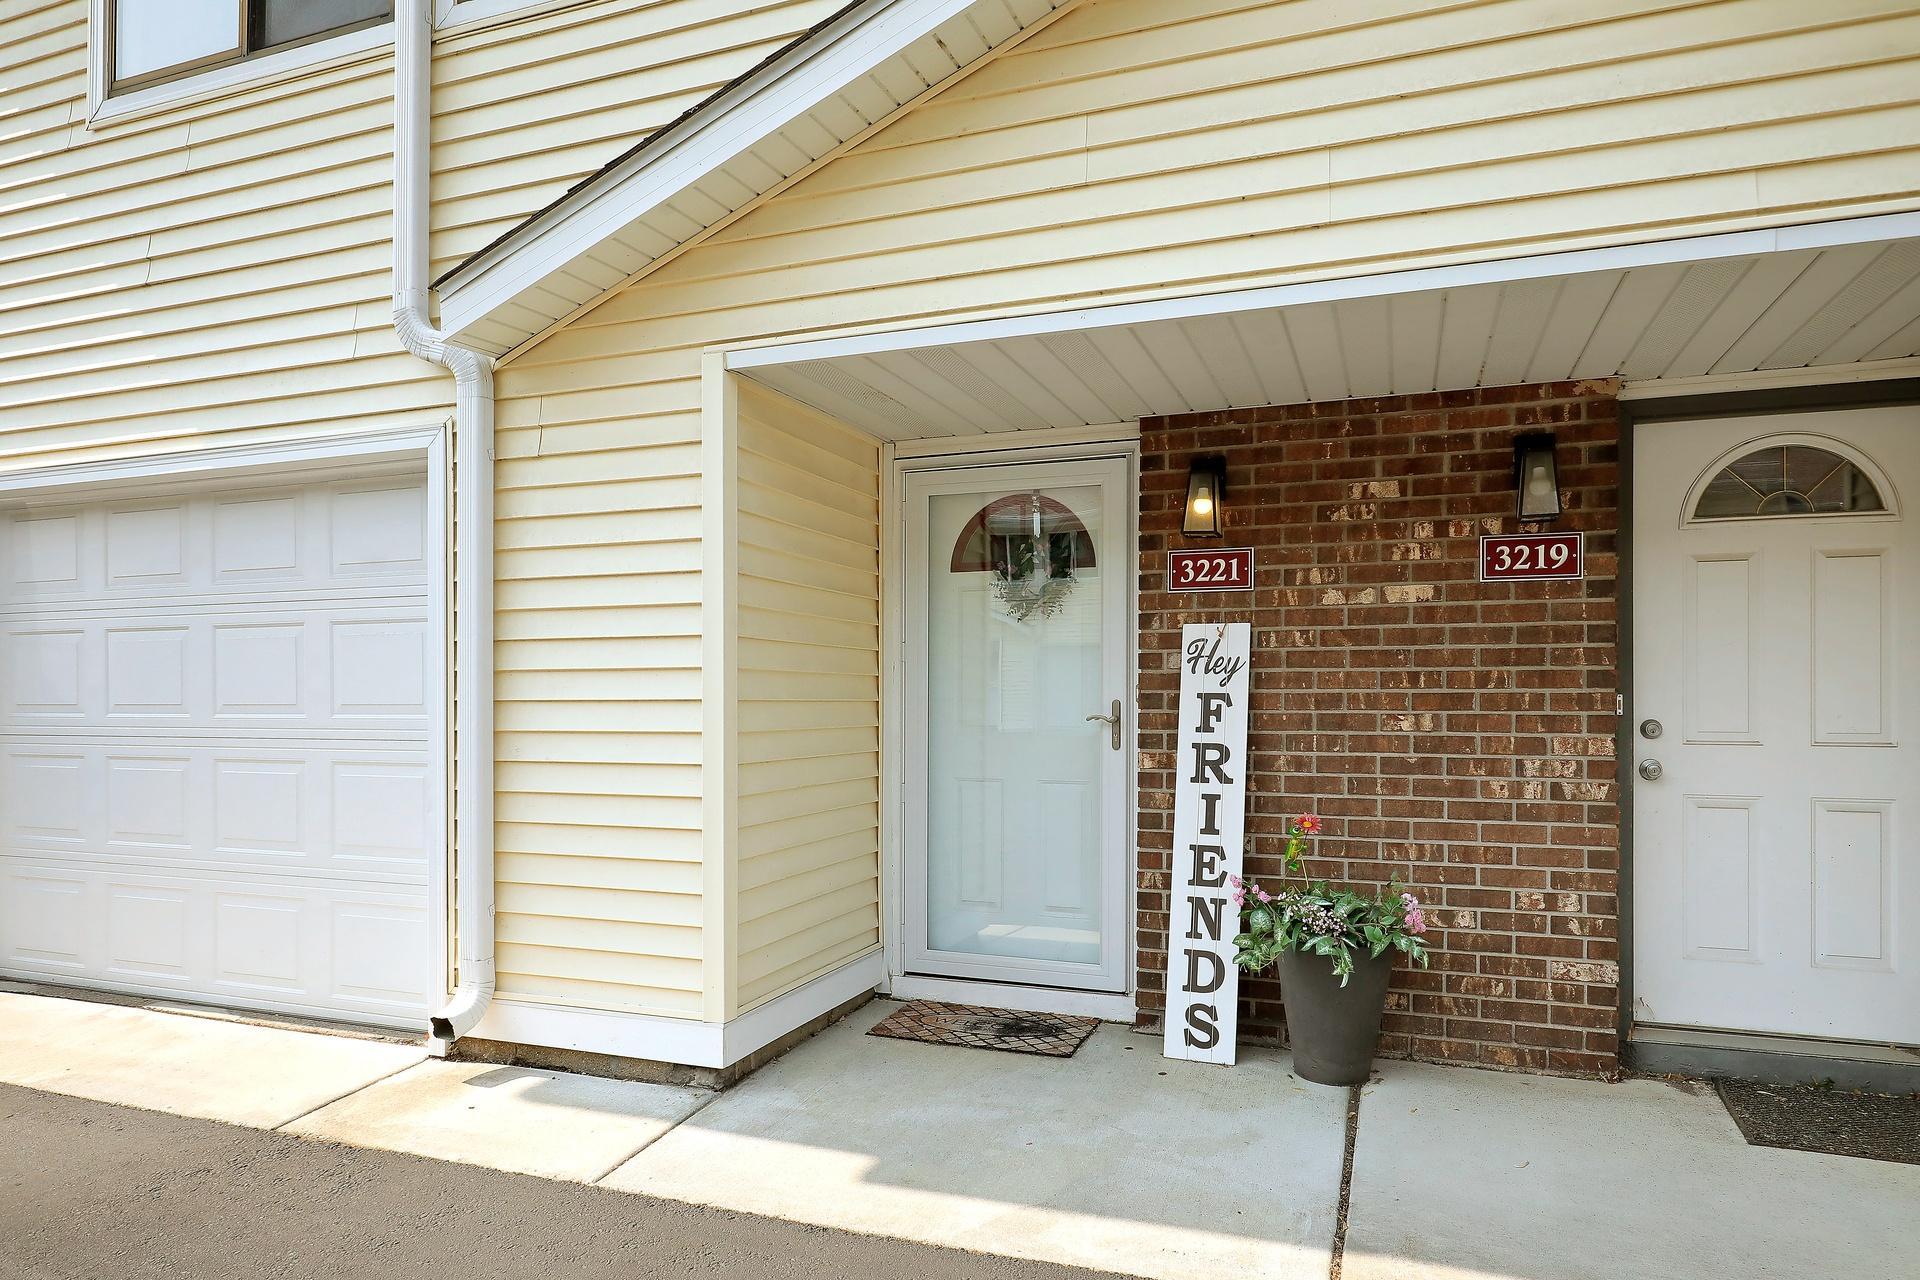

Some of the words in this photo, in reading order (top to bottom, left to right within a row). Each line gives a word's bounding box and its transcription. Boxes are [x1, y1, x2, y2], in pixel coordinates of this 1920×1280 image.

[1180, 558, 1240, 583] 3221
[1494, 543, 1569, 571] 3219
[1186, 637, 1246, 687] Hey
[1182, 692, 1234, 1049] FRIENDS
